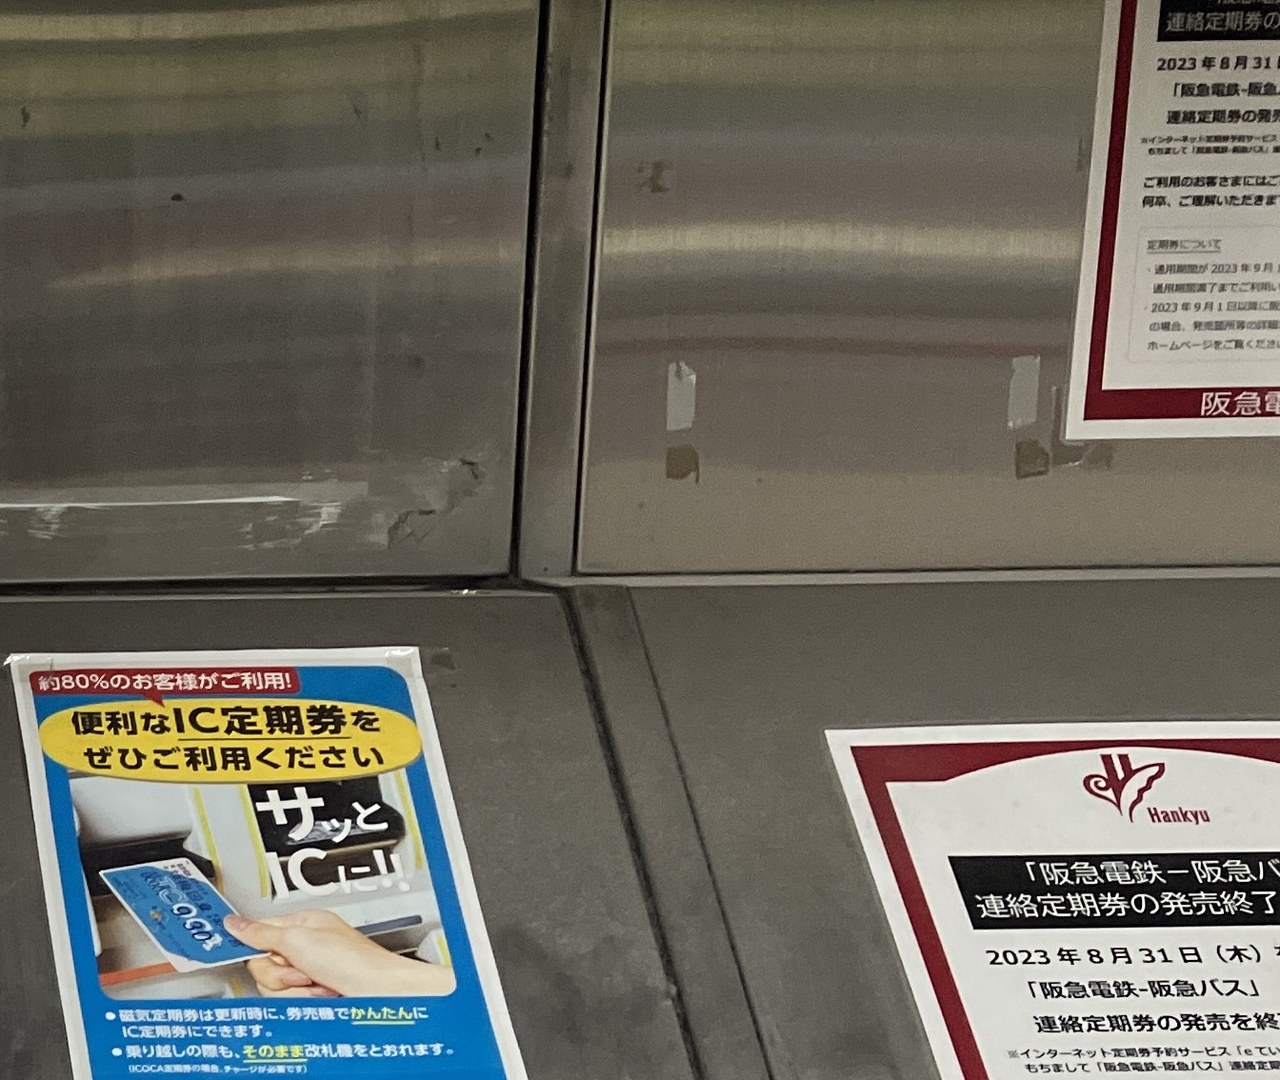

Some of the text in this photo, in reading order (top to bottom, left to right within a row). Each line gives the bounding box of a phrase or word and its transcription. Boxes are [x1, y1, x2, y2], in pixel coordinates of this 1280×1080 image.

[70, 704, 381, 737] 便利なIC定期券を
[82, 745, 386, 772] ぜひご利用ください
[1147, 806, 1211, 826] Hankyu
